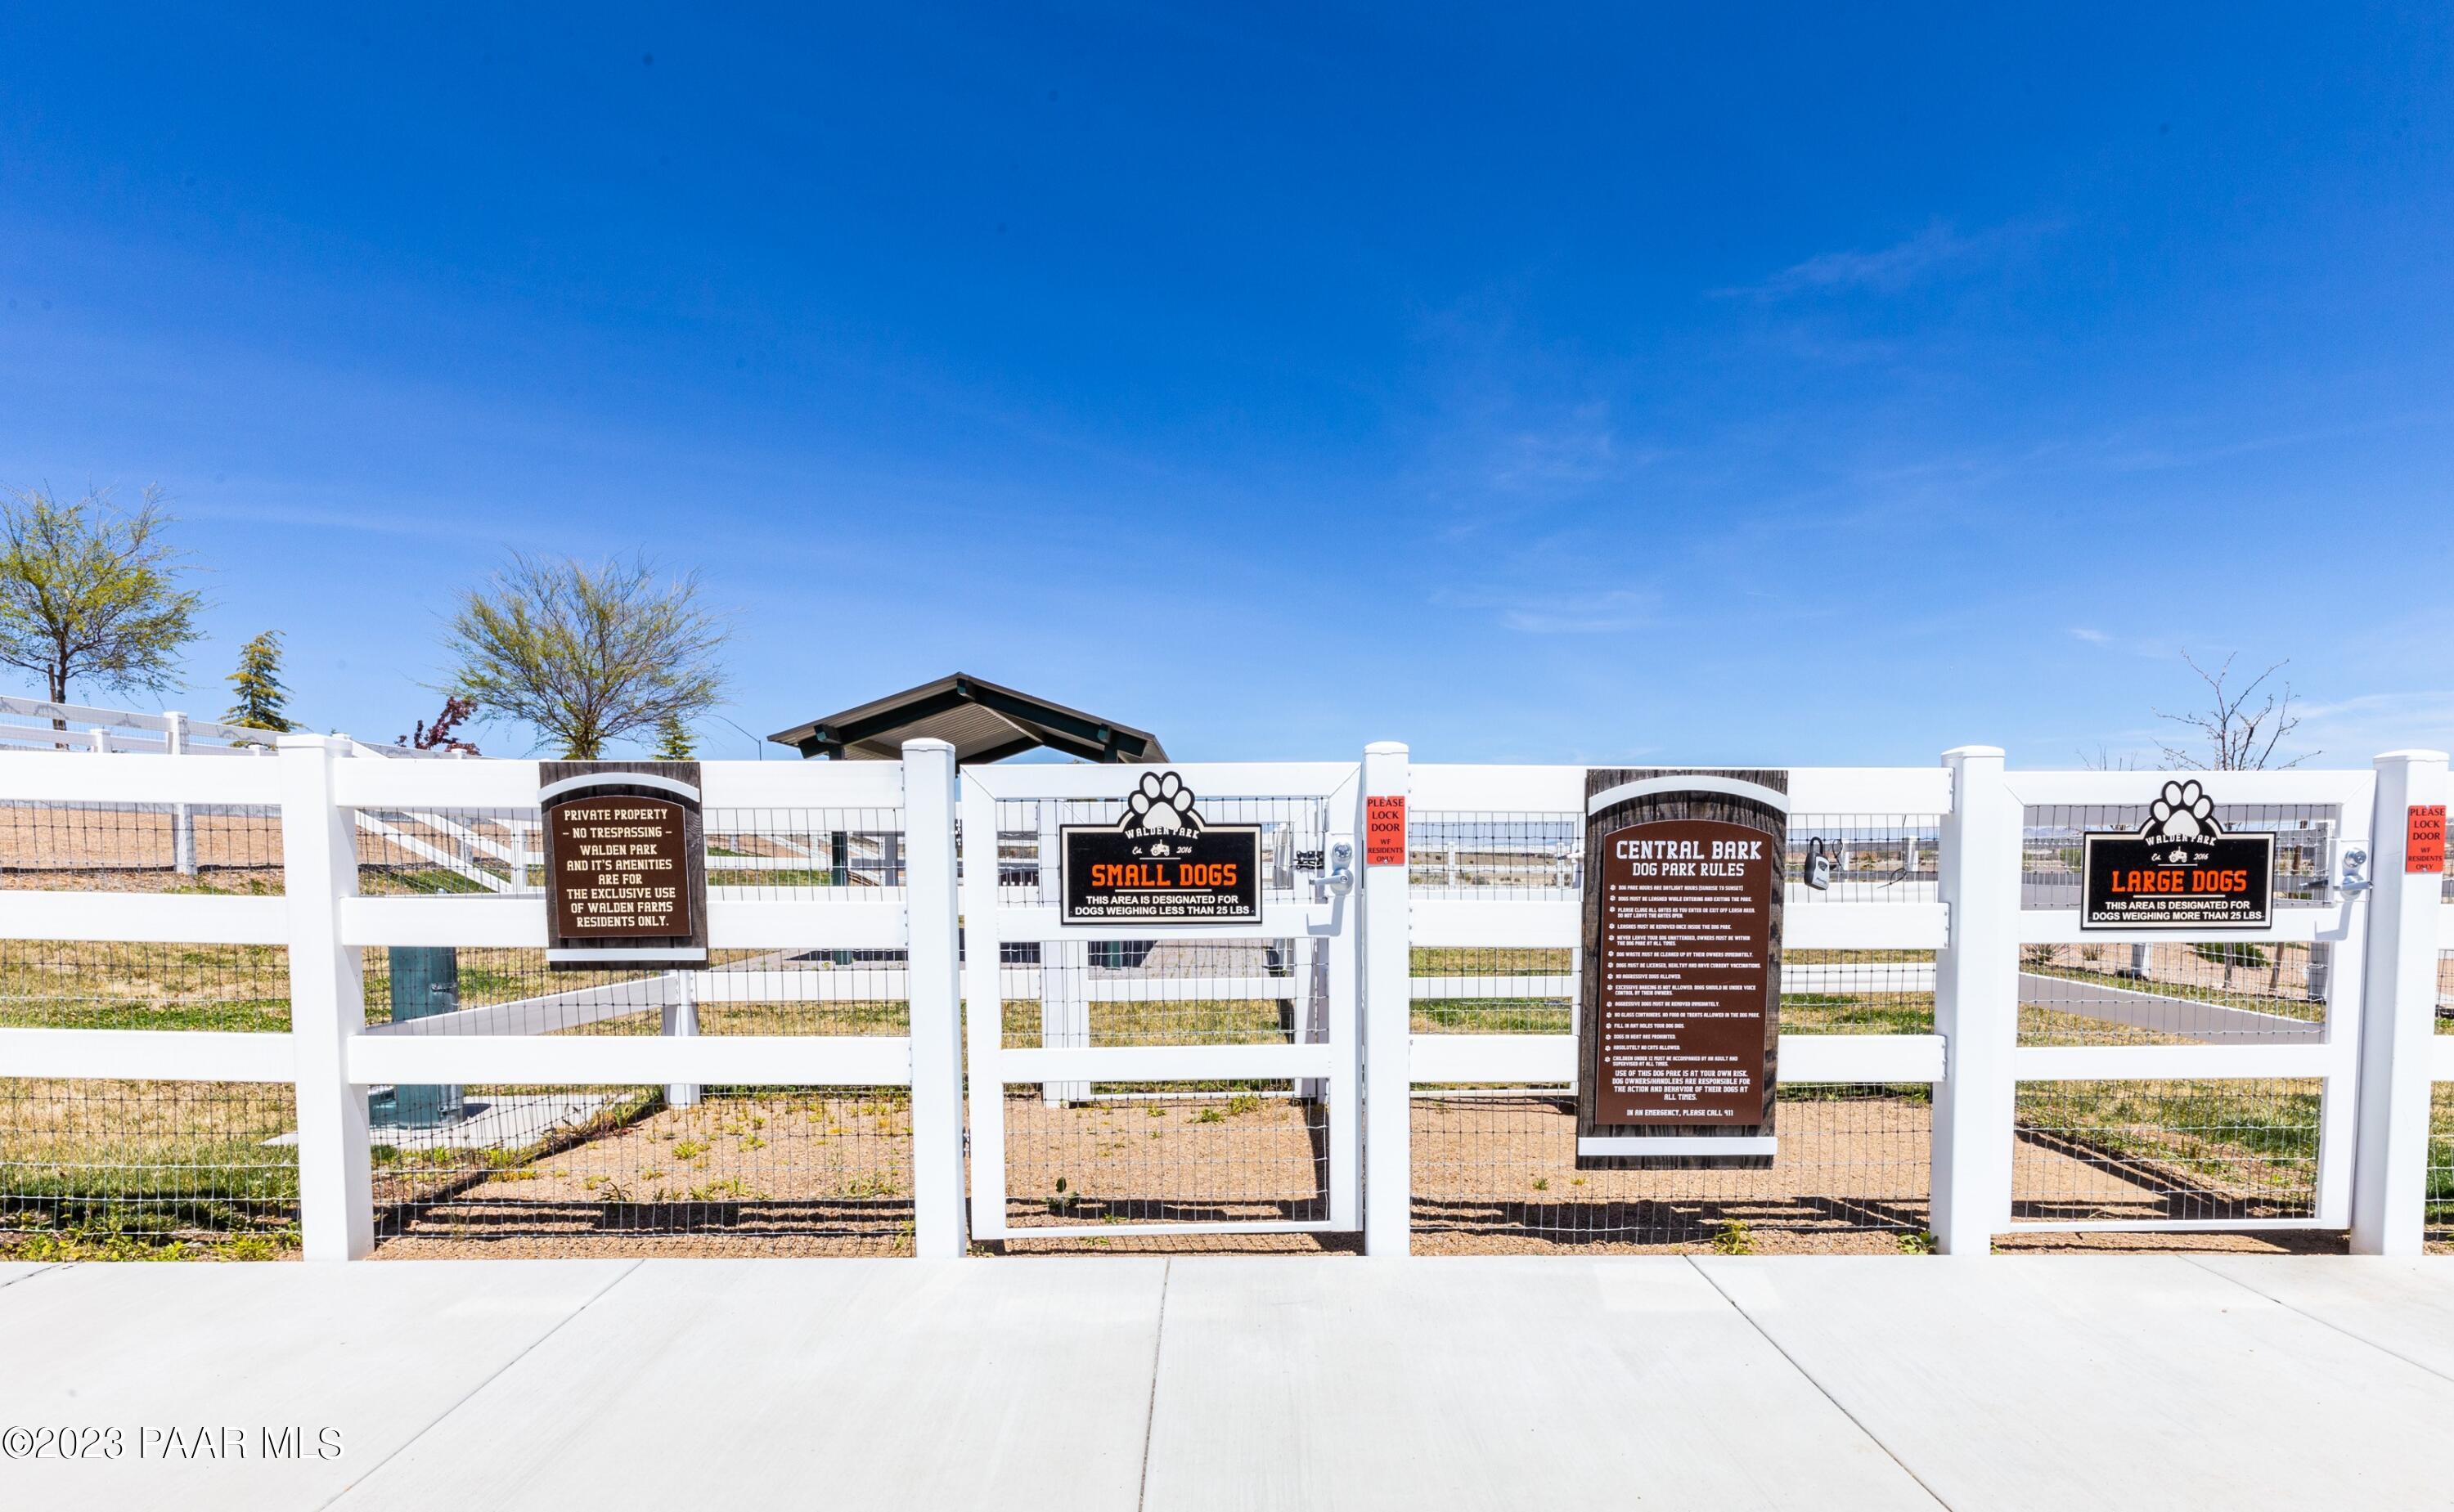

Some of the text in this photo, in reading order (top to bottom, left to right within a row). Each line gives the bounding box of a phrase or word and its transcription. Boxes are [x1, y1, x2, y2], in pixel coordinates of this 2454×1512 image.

[1368, 799, 1404, 807] PLEASE
[564, 809, 667, 821] PRIVATE PROPERTY
[1372, 811, 1399, 819] LOCK
[573, 826, 662, 838] NO TRESPASSING
[1125, 826, 1200, 839] WALDEN PARK
[2145, 834, 2216, 846] WALDEN PARK
[580, 844, 657, 856] WALDEN PARK
[1616, 840, 1761, 860] CENTRAL BARK
[567, 859, 672, 871] AND IT'S AMENITIES
[1632, 862, 1744, 876] DOG PARK RULES
[598, 874, 642, 885] ARE FOR
[1092, 864, 1237, 886] SMALL DOGS
[2112, 870, 2247, 892] LARGE DOGS
[567, 887, 675, 899] THE EXCLUSIVE USE
[1086, 895, 1238, 904] THIS AREA IS DESIGNATED FOR
[2106, 901, 2250, 910] THIS AREA IS DESIGNATED FOR
[571, 901, 673, 913] OF WALDEN FARMS
[1075, 906, 1249, 915] DOGS WEIGHING LESS THAN 25 LBS
[577, 915, 669, 927] RESIDENTS ONLY.
[2092, 911, 2262, 920] DOGS WEIGHING MORE THAN 25 LBS
